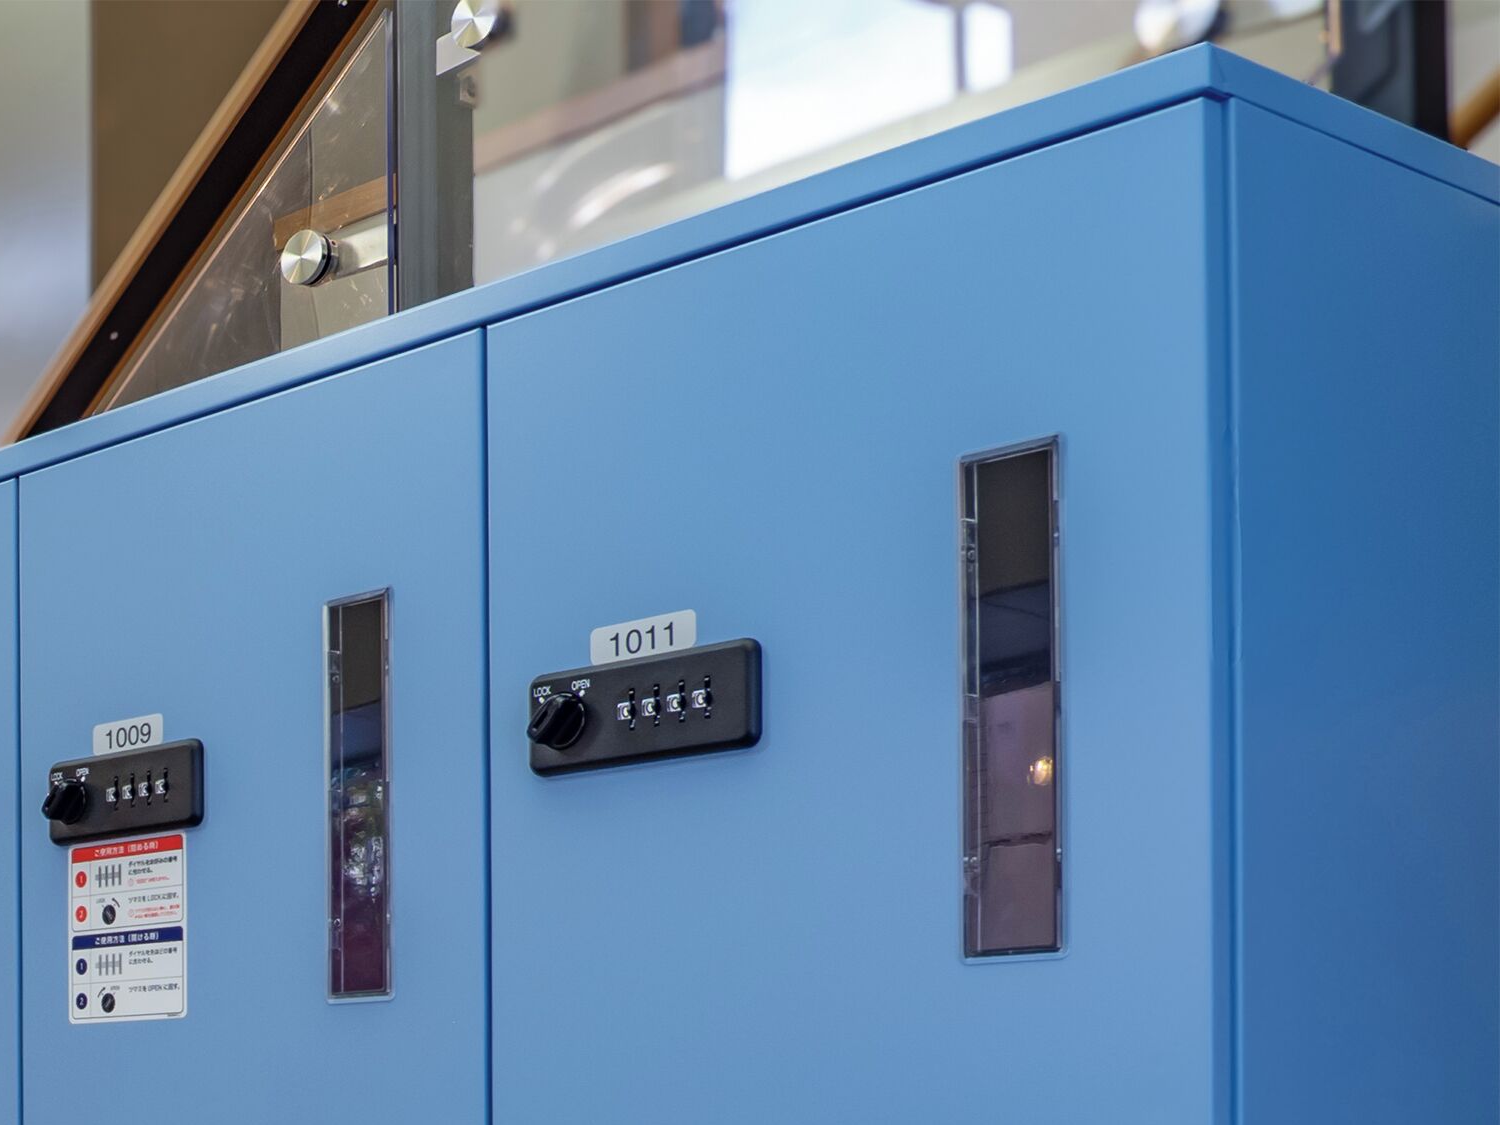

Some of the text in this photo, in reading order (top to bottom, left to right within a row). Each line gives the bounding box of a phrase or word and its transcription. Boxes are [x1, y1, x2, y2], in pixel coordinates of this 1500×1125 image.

[609, 621, 675, 657] 1011
[533, 686, 551, 697] LOCK
[571, 679, 590, 691] OPEN
[105, 723, 152, 750] 1009
